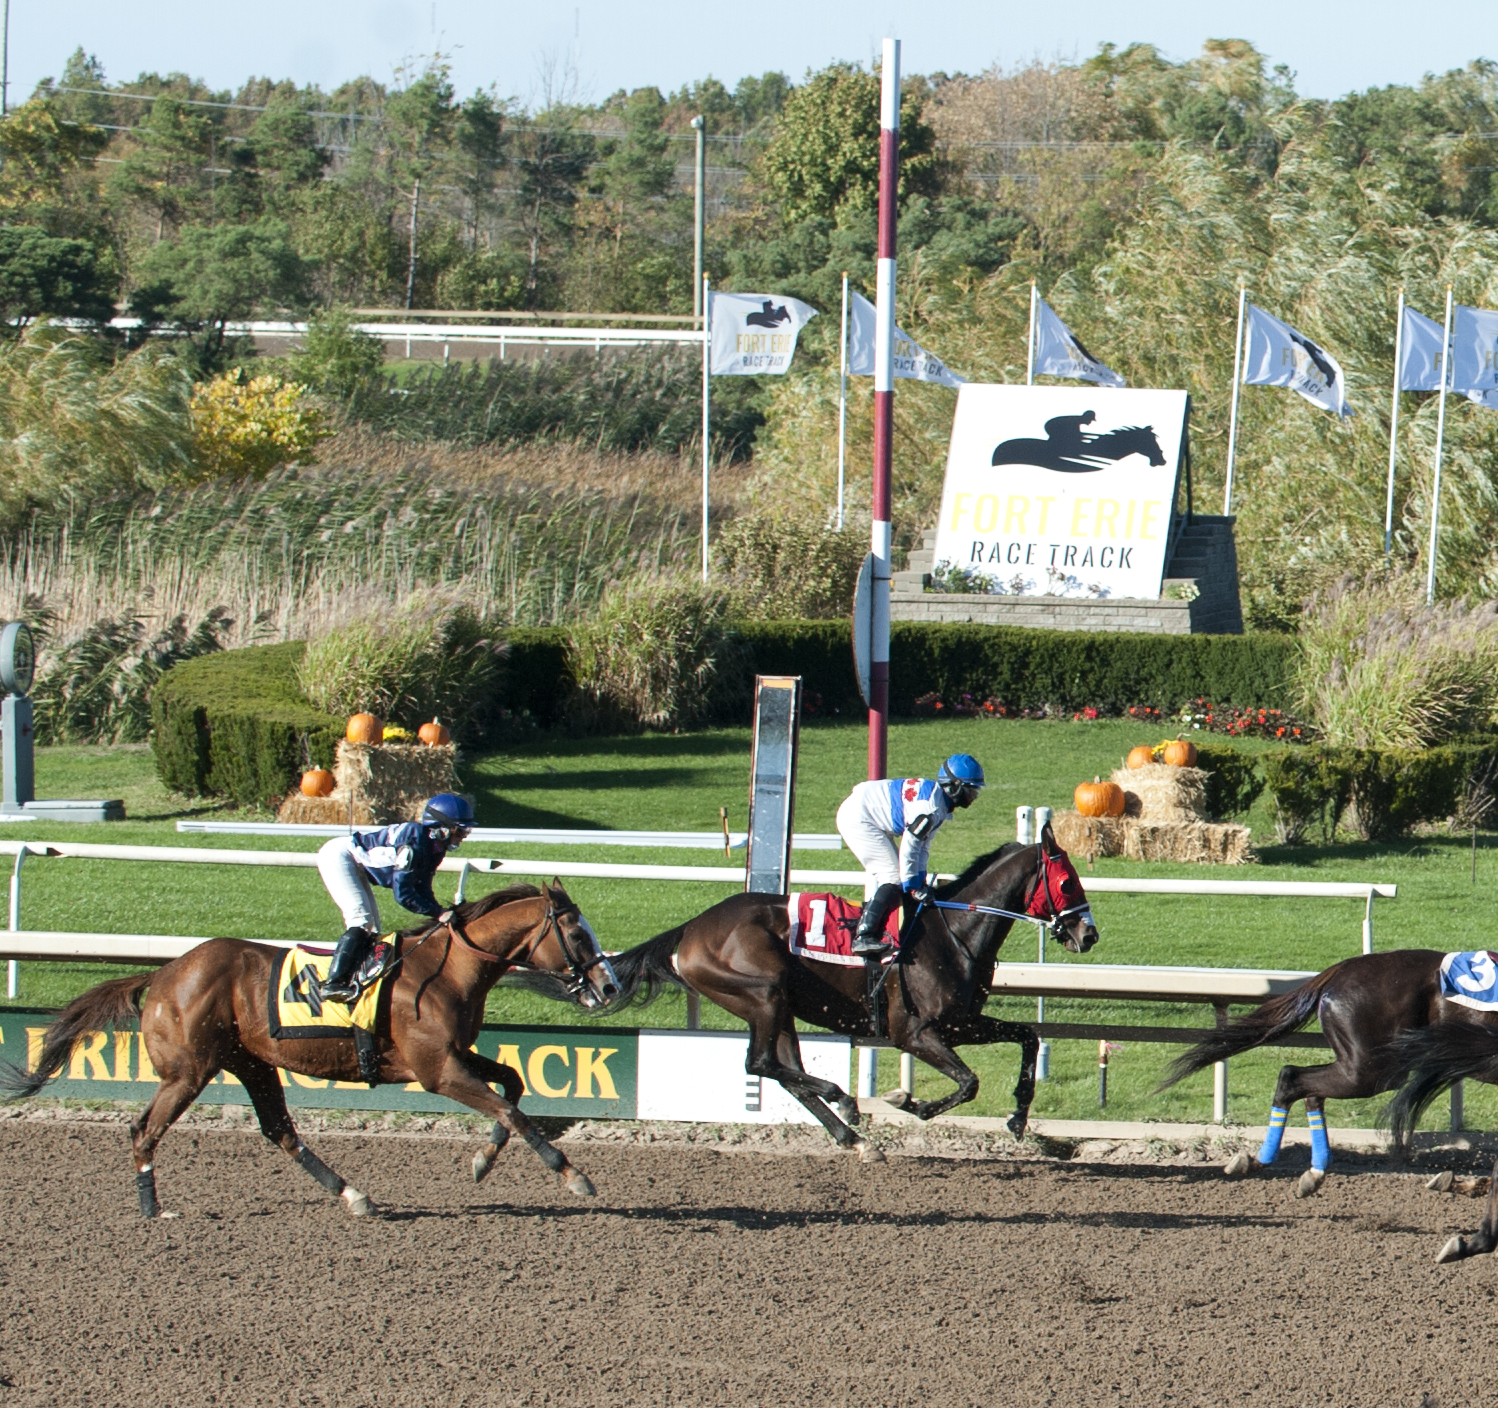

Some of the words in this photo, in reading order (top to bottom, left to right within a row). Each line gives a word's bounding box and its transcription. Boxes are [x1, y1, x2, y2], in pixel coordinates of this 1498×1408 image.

[736, 334, 767, 353] FORT
[771, 334, 791, 353] ERIE
[743, 355, 763, 367] RACE
[918, 361, 943, 377] TACK
[950, 492, 1057, 536] FORT
[1070, 497, 1162, 540] ERIE
[970, 541, 1037, 565] RACE
[1049, 544, 1134, 569] TRACK
[805, 899, 827, 948] 1
[1456, 950, 1497, 992] 3
